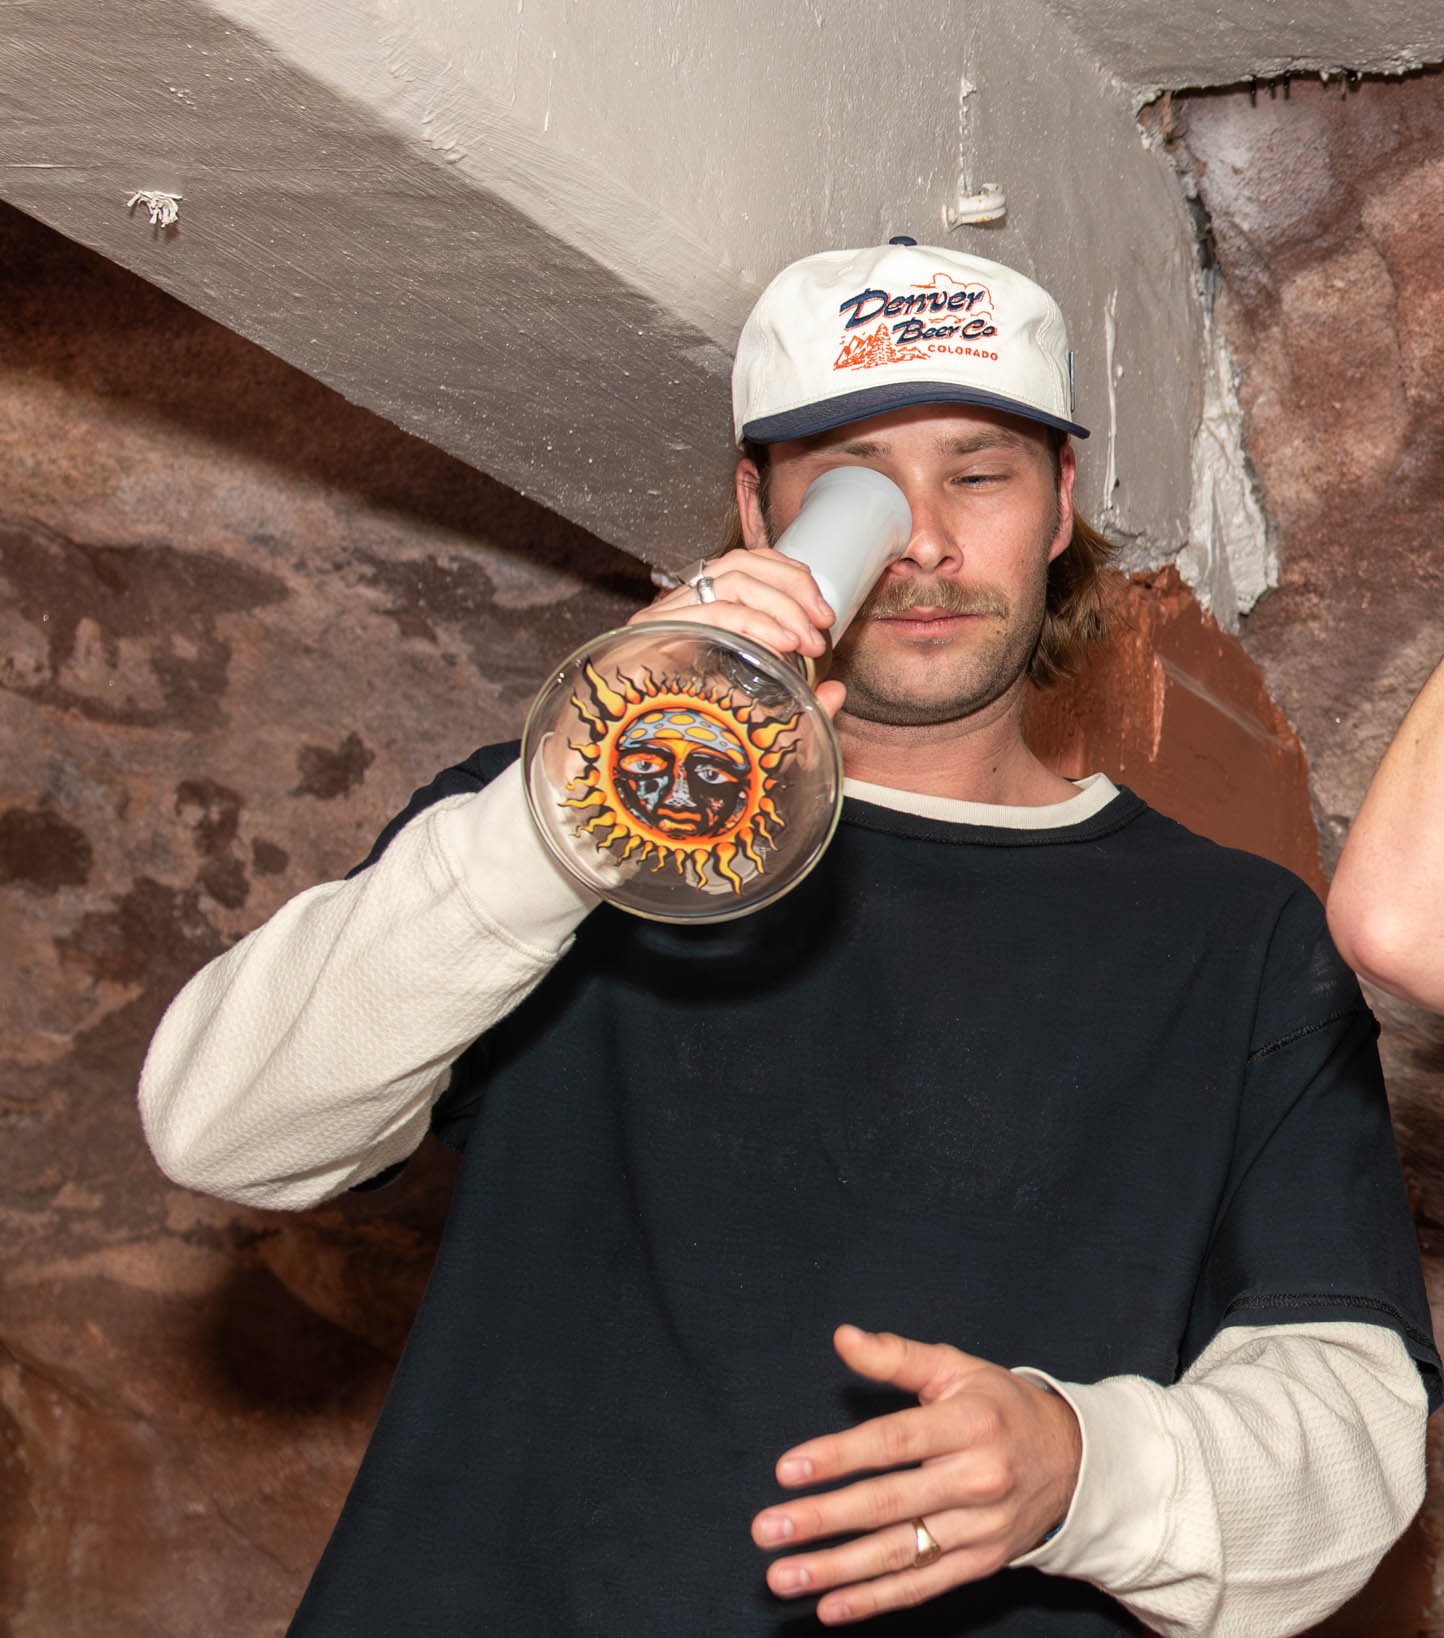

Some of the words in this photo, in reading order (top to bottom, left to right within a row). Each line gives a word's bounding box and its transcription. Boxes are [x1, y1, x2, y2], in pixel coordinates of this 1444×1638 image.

[839, 288, 987, 331] Denver
[892, 317, 960, 345] Beer
[961, 319, 998, 341] Co
[927, 344, 999, 361] COLORADO
